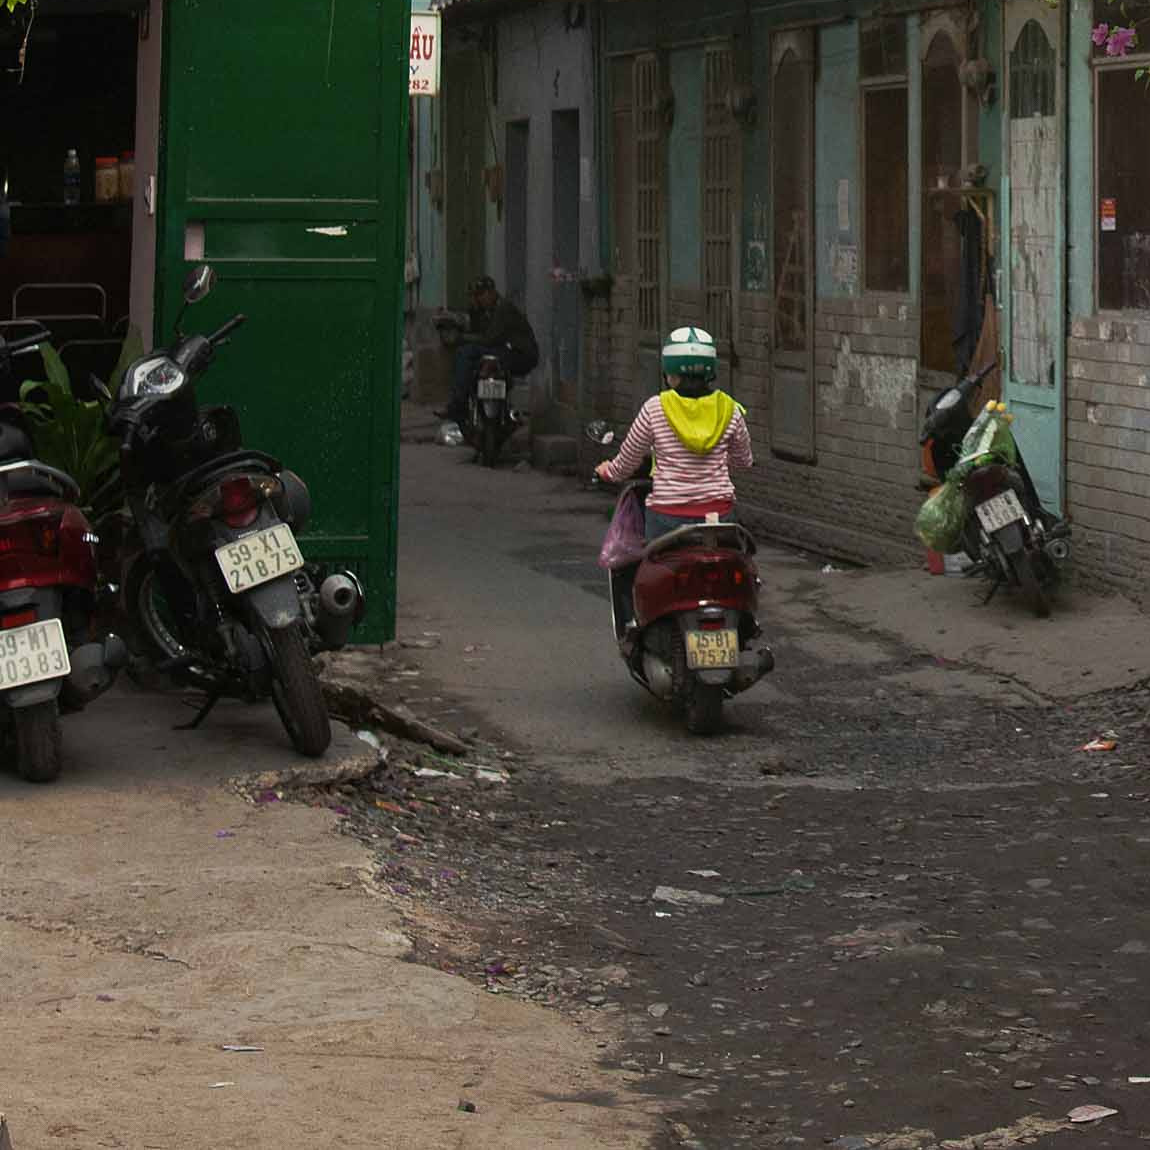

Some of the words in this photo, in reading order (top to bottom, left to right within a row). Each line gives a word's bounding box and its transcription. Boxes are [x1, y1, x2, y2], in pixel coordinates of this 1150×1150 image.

[410, 25, 434, 60] ẦU
[228, 531, 280, 566] 59-X1
[231, 547, 297, 588] 218.75
[0, 650, 63, 683] 03.83
